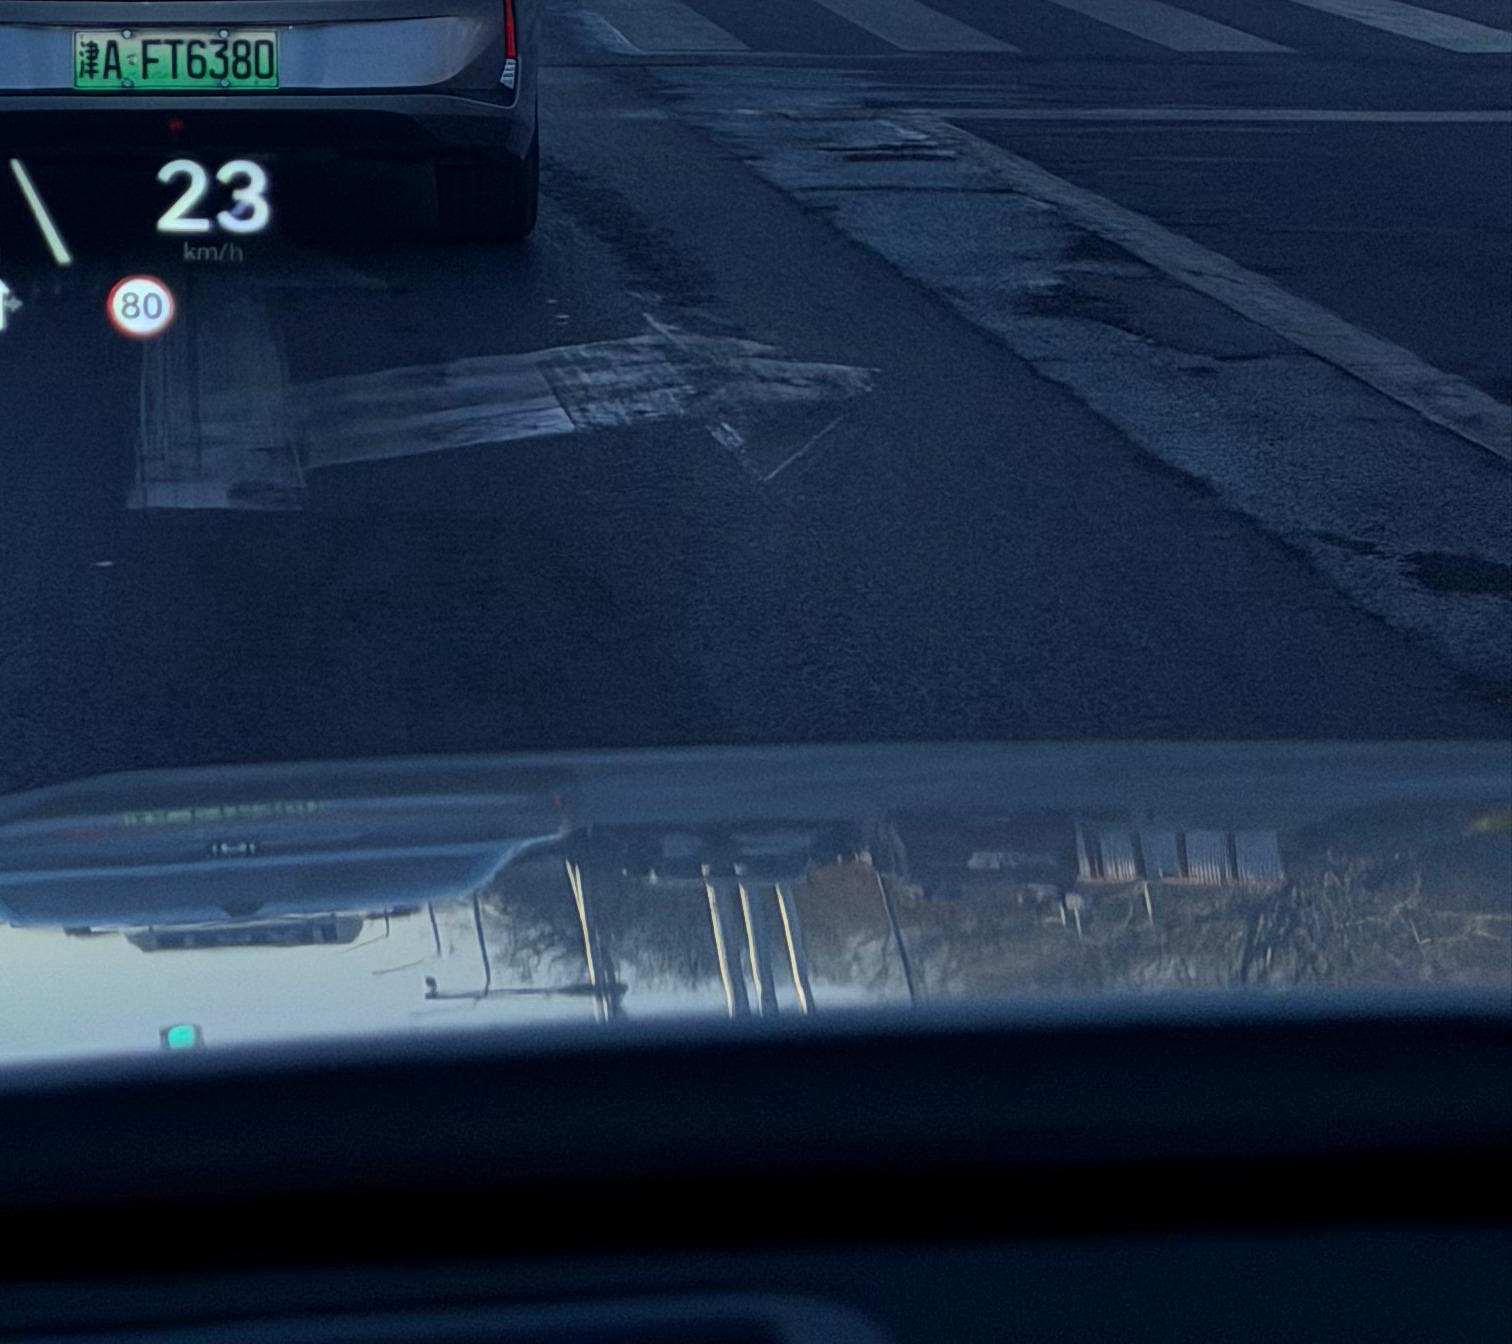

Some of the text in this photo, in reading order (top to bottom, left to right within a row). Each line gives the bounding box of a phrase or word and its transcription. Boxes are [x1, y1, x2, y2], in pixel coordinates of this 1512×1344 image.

[156, 159, 271, 233] 23
[183, 242, 244, 263] km/h
[120, 291, 164, 321] 80
